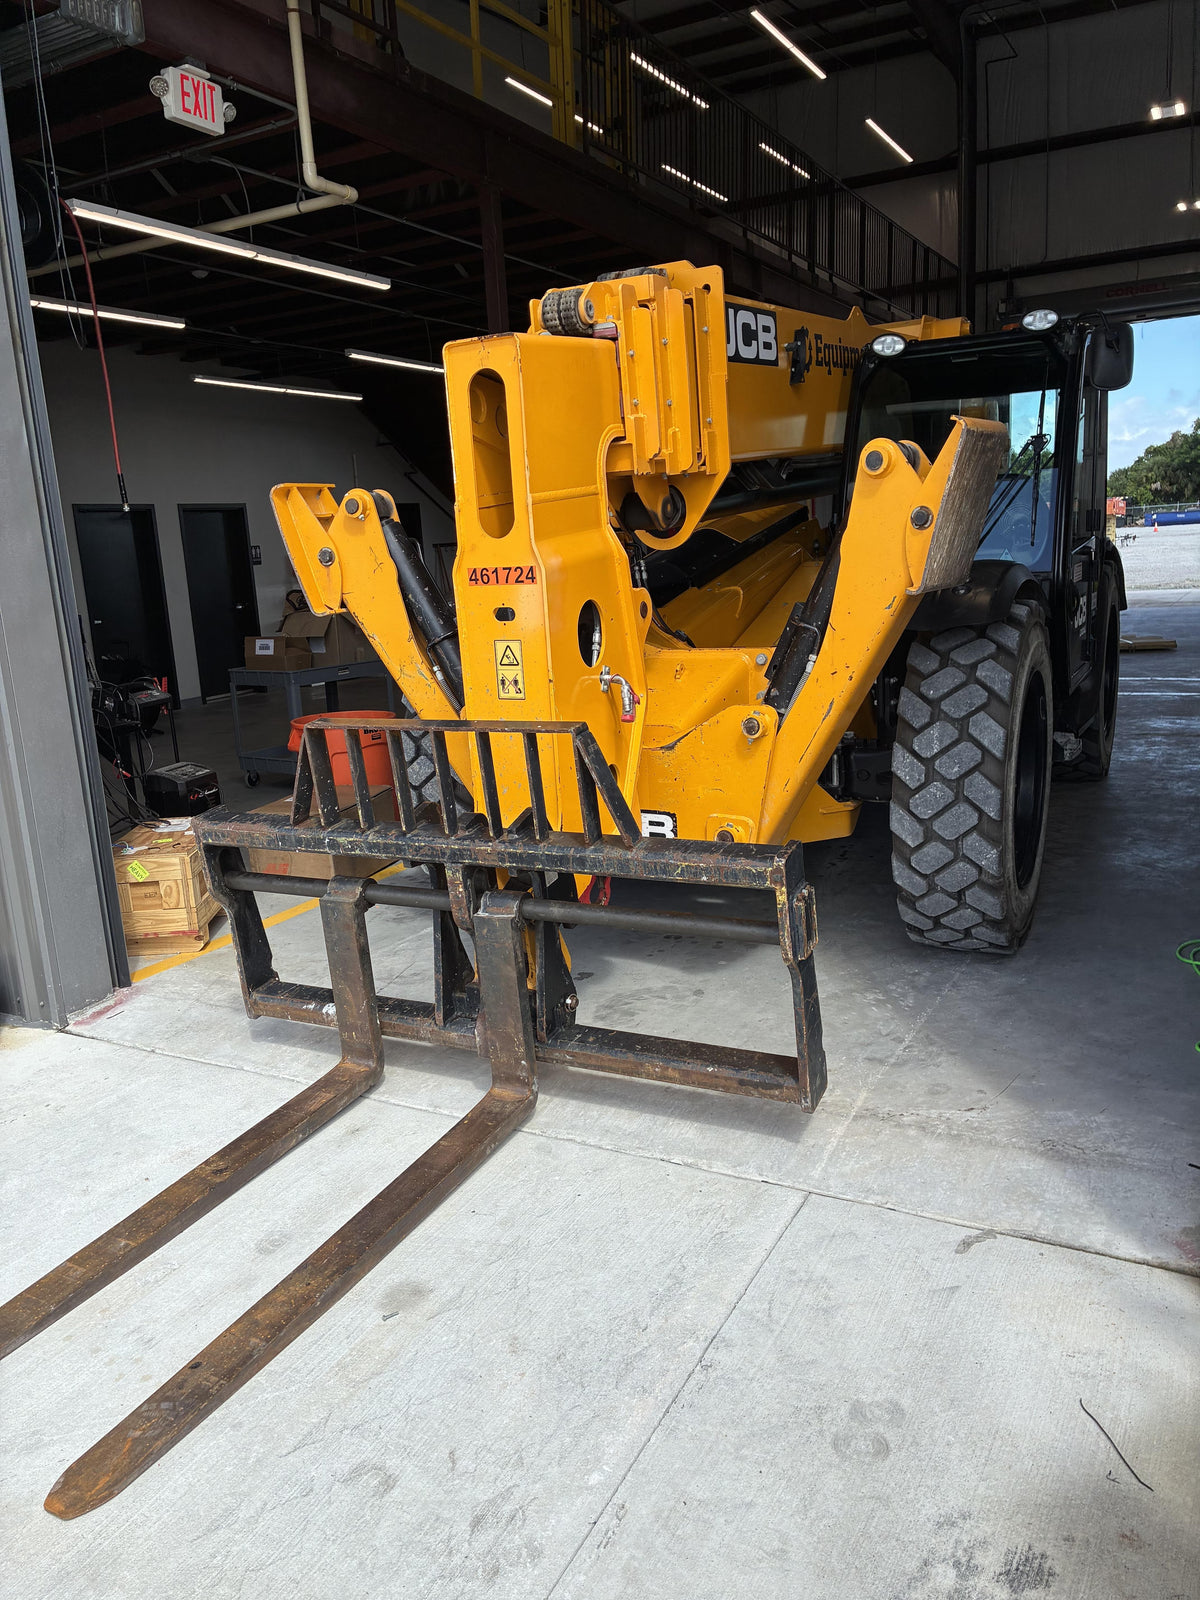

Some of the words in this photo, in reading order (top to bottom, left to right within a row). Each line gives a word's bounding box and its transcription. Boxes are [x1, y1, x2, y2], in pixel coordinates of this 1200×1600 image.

[180, 73, 216, 123] EXIT
[727, 308, 777, 361] JCB
[814, 333, 860, 377] Equipm
[469, 566, 536, 585] 461724
